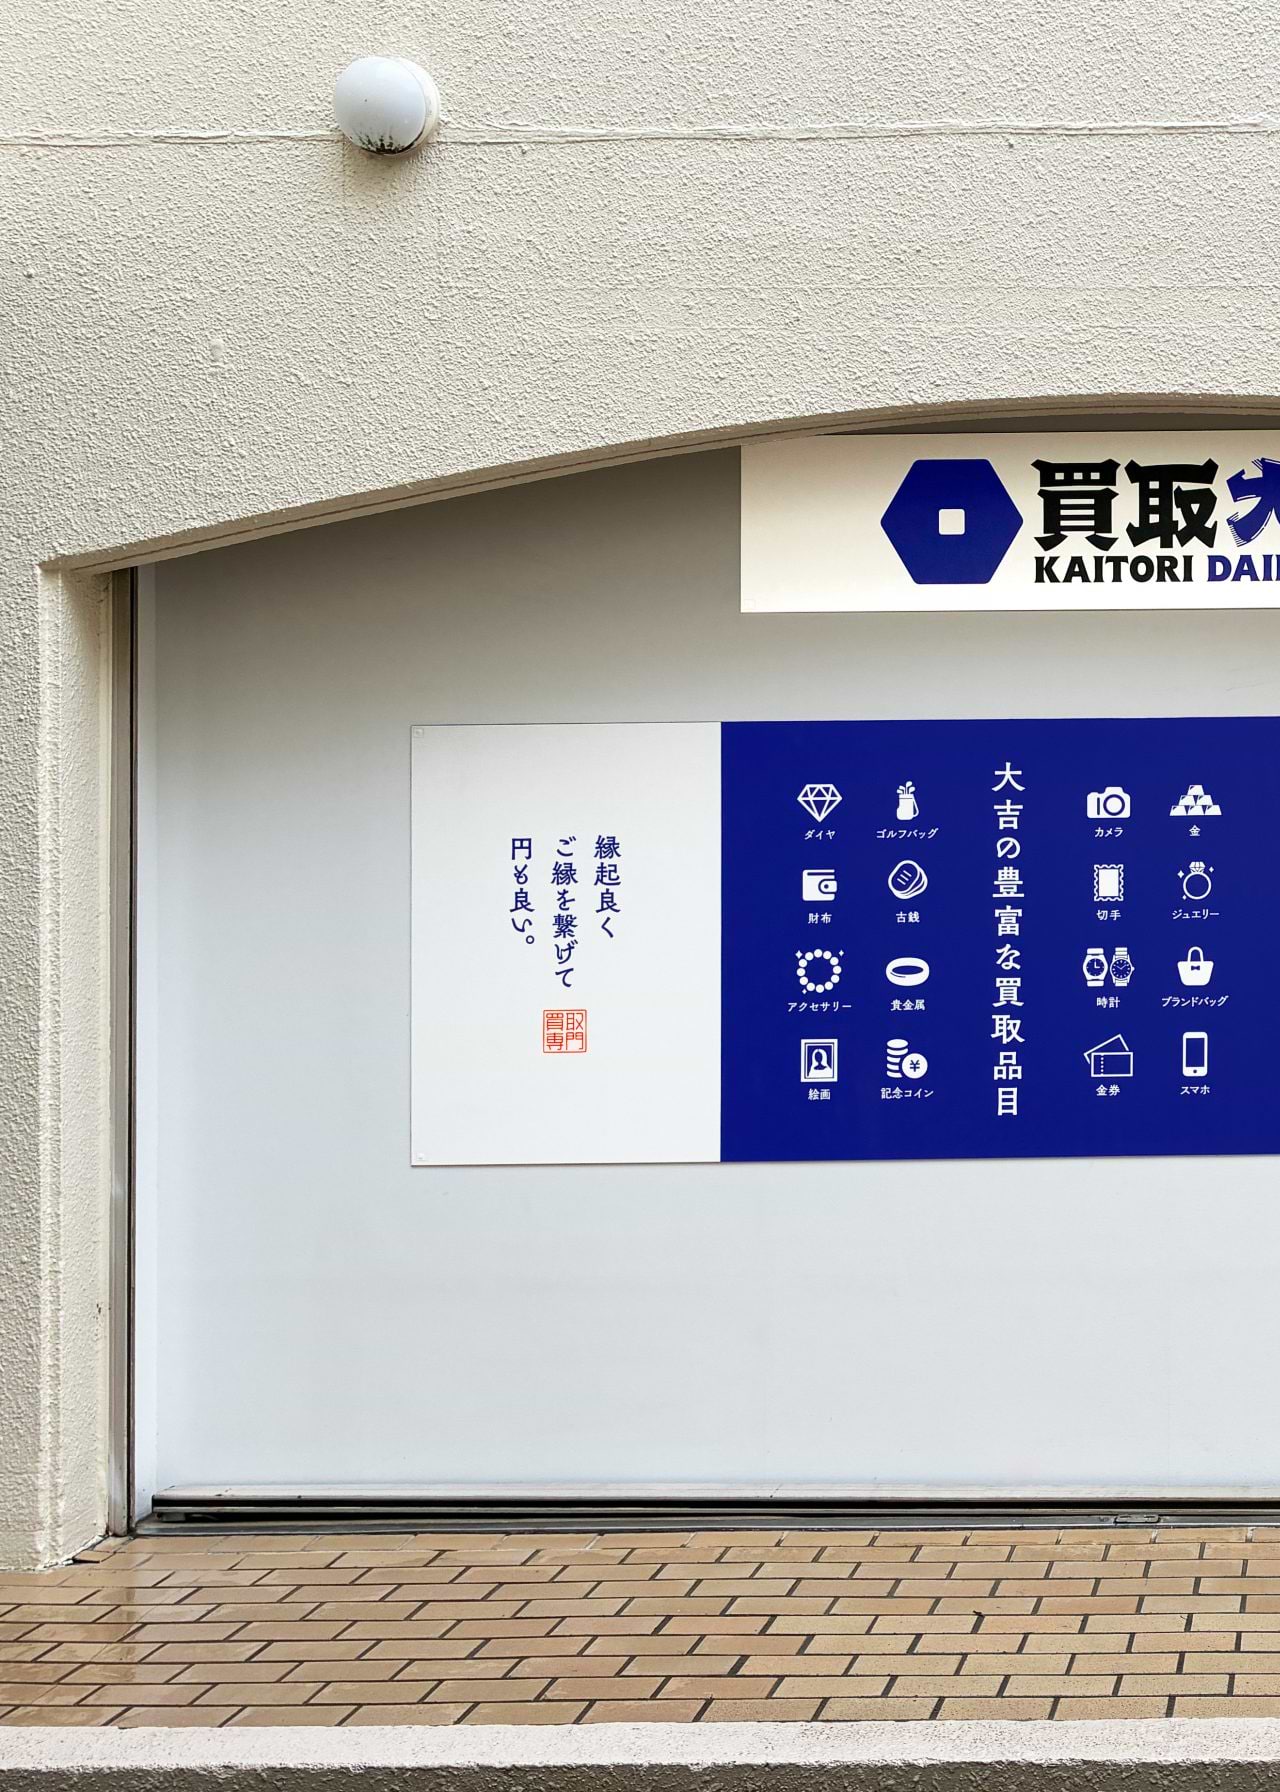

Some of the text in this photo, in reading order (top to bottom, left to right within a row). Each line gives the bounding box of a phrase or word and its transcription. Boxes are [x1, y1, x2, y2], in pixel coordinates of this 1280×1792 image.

[1034, 555, 1194, 583] KAITORI
[804, 829, 836, 841] ダイヤ
[876, 827, 939, 840] ゴルフバッグ
[1094, 826, 1124, 838] カメラ
[1188, 824, 1201, 837] 金
[510, 838, 535, 944] 円も良い。
[594, 835, 621, 938] 縁起良く
[551, 836, 578, 987] ご縁を繋げて
[807, 911, 833, 925] 財布
[895, 910, 920, 923] 古銭
[1096, 909, 1122, 921] 切手
[1171, 908, 1220, 920] ジュエリー
[991, 762, 1025, 1115] 大吉の豊富な買取品目
[787, 1000, 852, 1013] アクセサリー
[890, 998, 927, 1012] 貴金属
[1095, 995, 1121, 1009] 時計
[1161, 995, 1230, 1008] ブランドバッグ
[807, 1087, 832, 1102] 絵画
[880, 1086, 934, 1100] 記念コイン
[1095, 1084, 1121, 1097] 金券
[1179, 1084, 1211, 1095] スマホ
